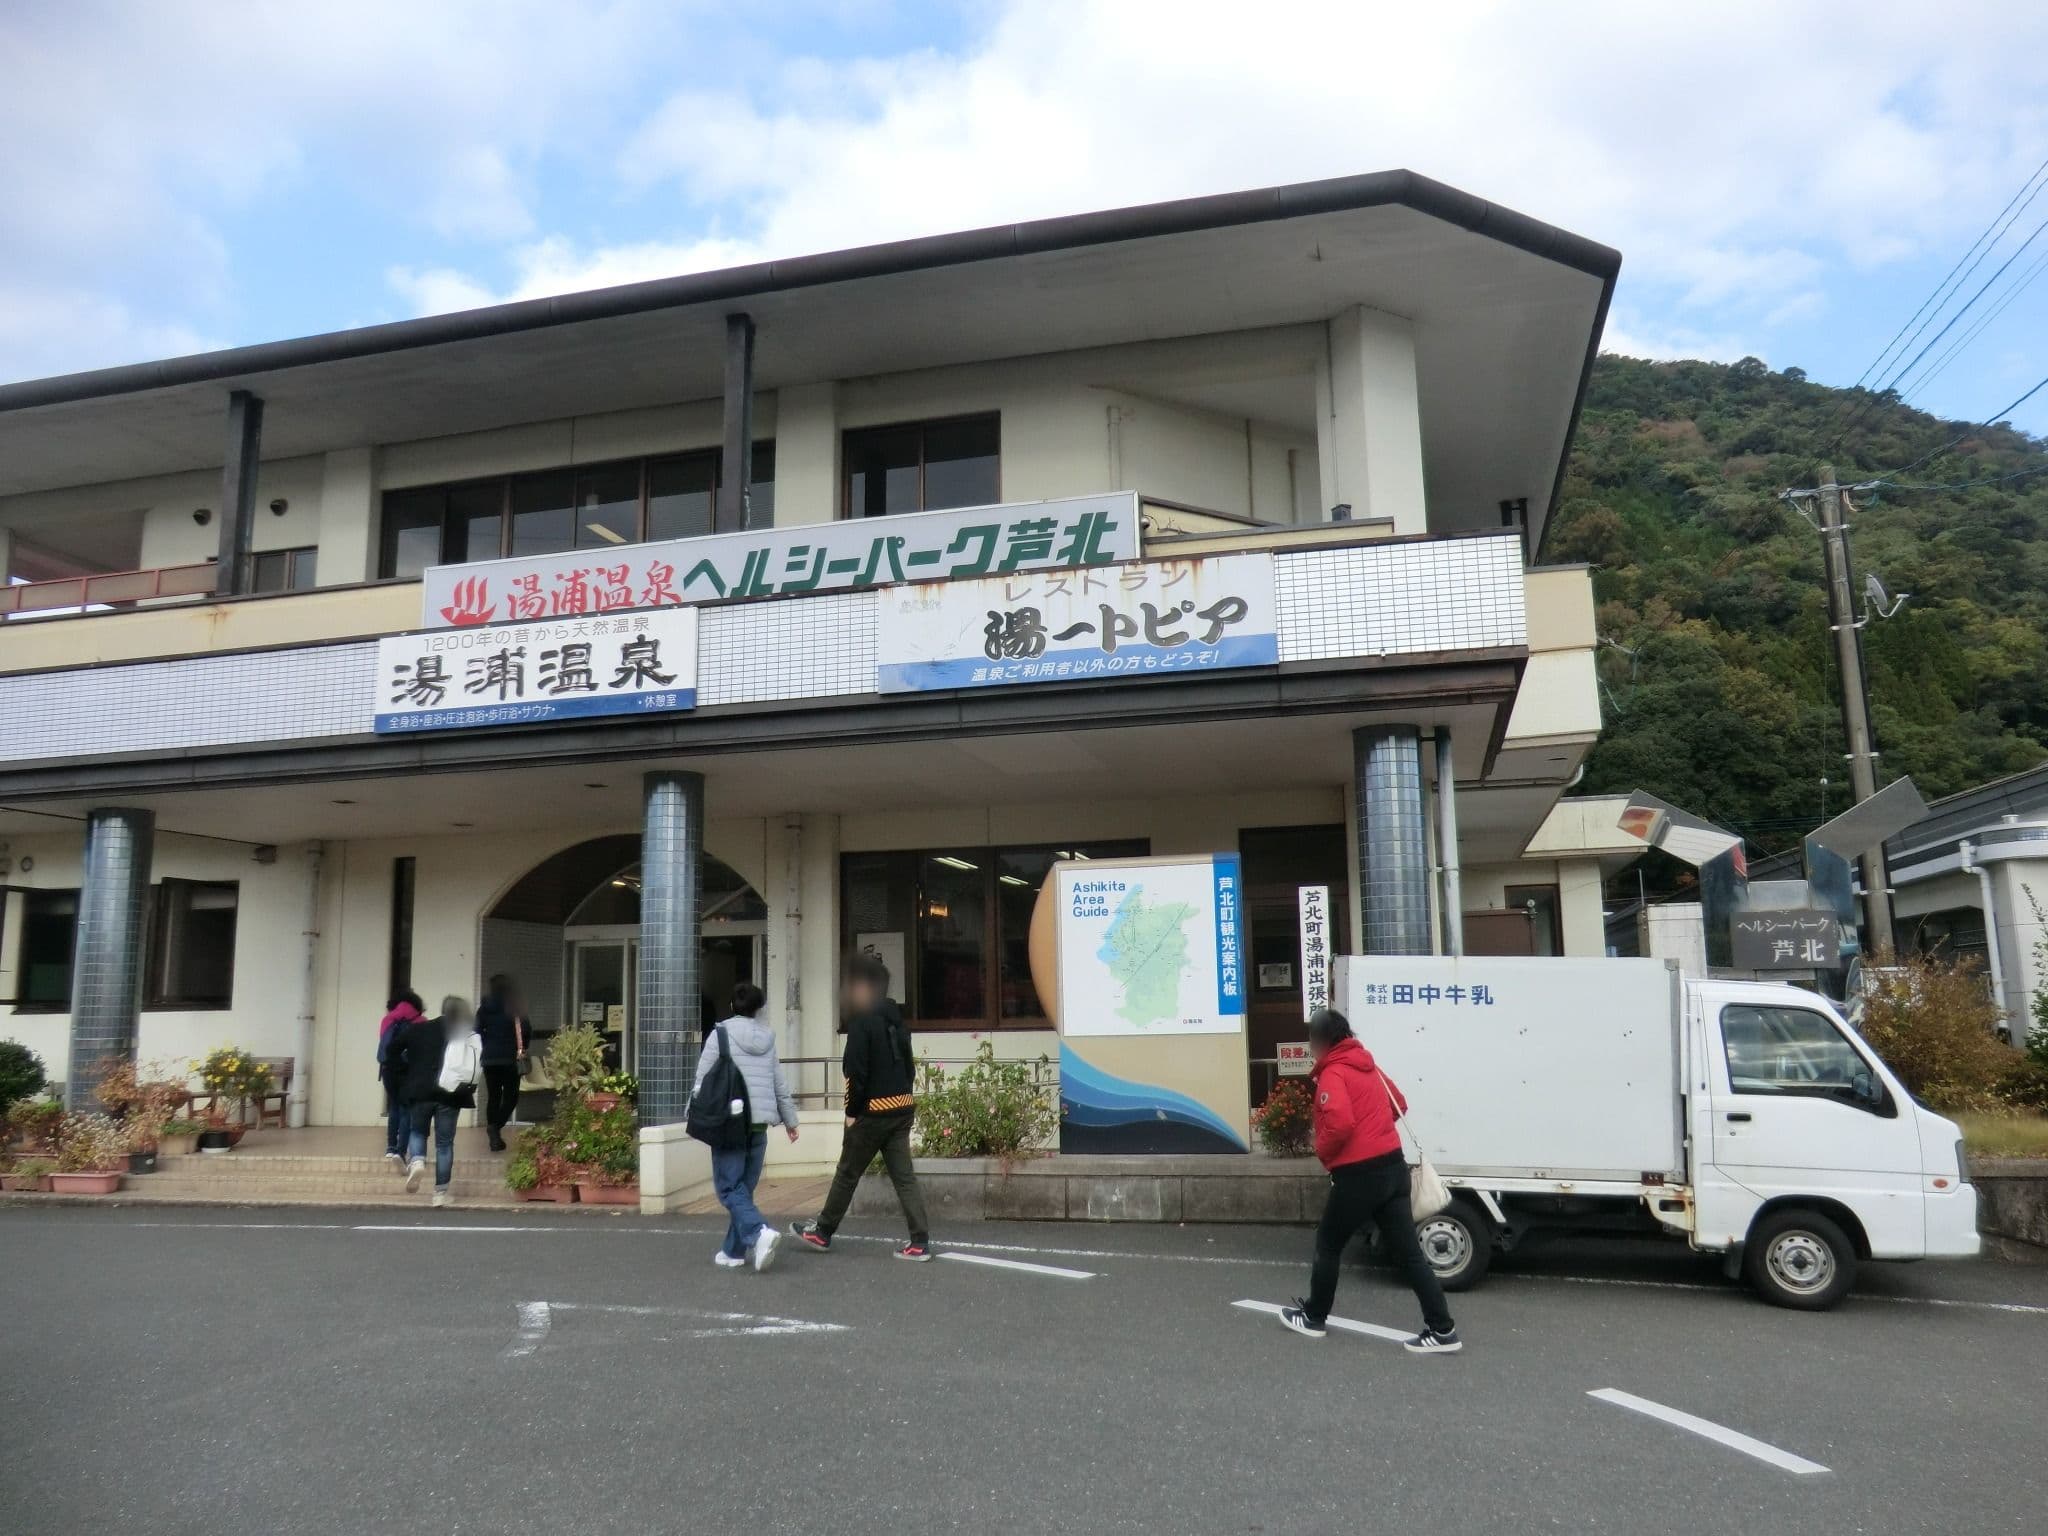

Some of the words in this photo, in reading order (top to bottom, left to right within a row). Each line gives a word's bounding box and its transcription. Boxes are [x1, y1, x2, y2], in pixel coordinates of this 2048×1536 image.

[507, 560, 682, 620] 湯浦温泉
[684, 511, 1118, 598] ヘルシーパーク芦北
[1006, 568, 1188, 601] レストラン
[424, 617, 650, 652] 1200年の昔から天然温泉
[390, 633, 679, 707] 湯浦温泉
[1073, 881, 1126, 893] Ashikita
[1073, 894, 1105, 905] Area
[1073, 906, 1109, 917] Guide
[1219, 877, 1237, 996] 芦北町観光案内板
[1737, 917, 1830, 933] ヘルシーパーク
[1771, 939, 1825, 963] 芦北
[1392, 984, 1494, 1006] 田中牛乳
